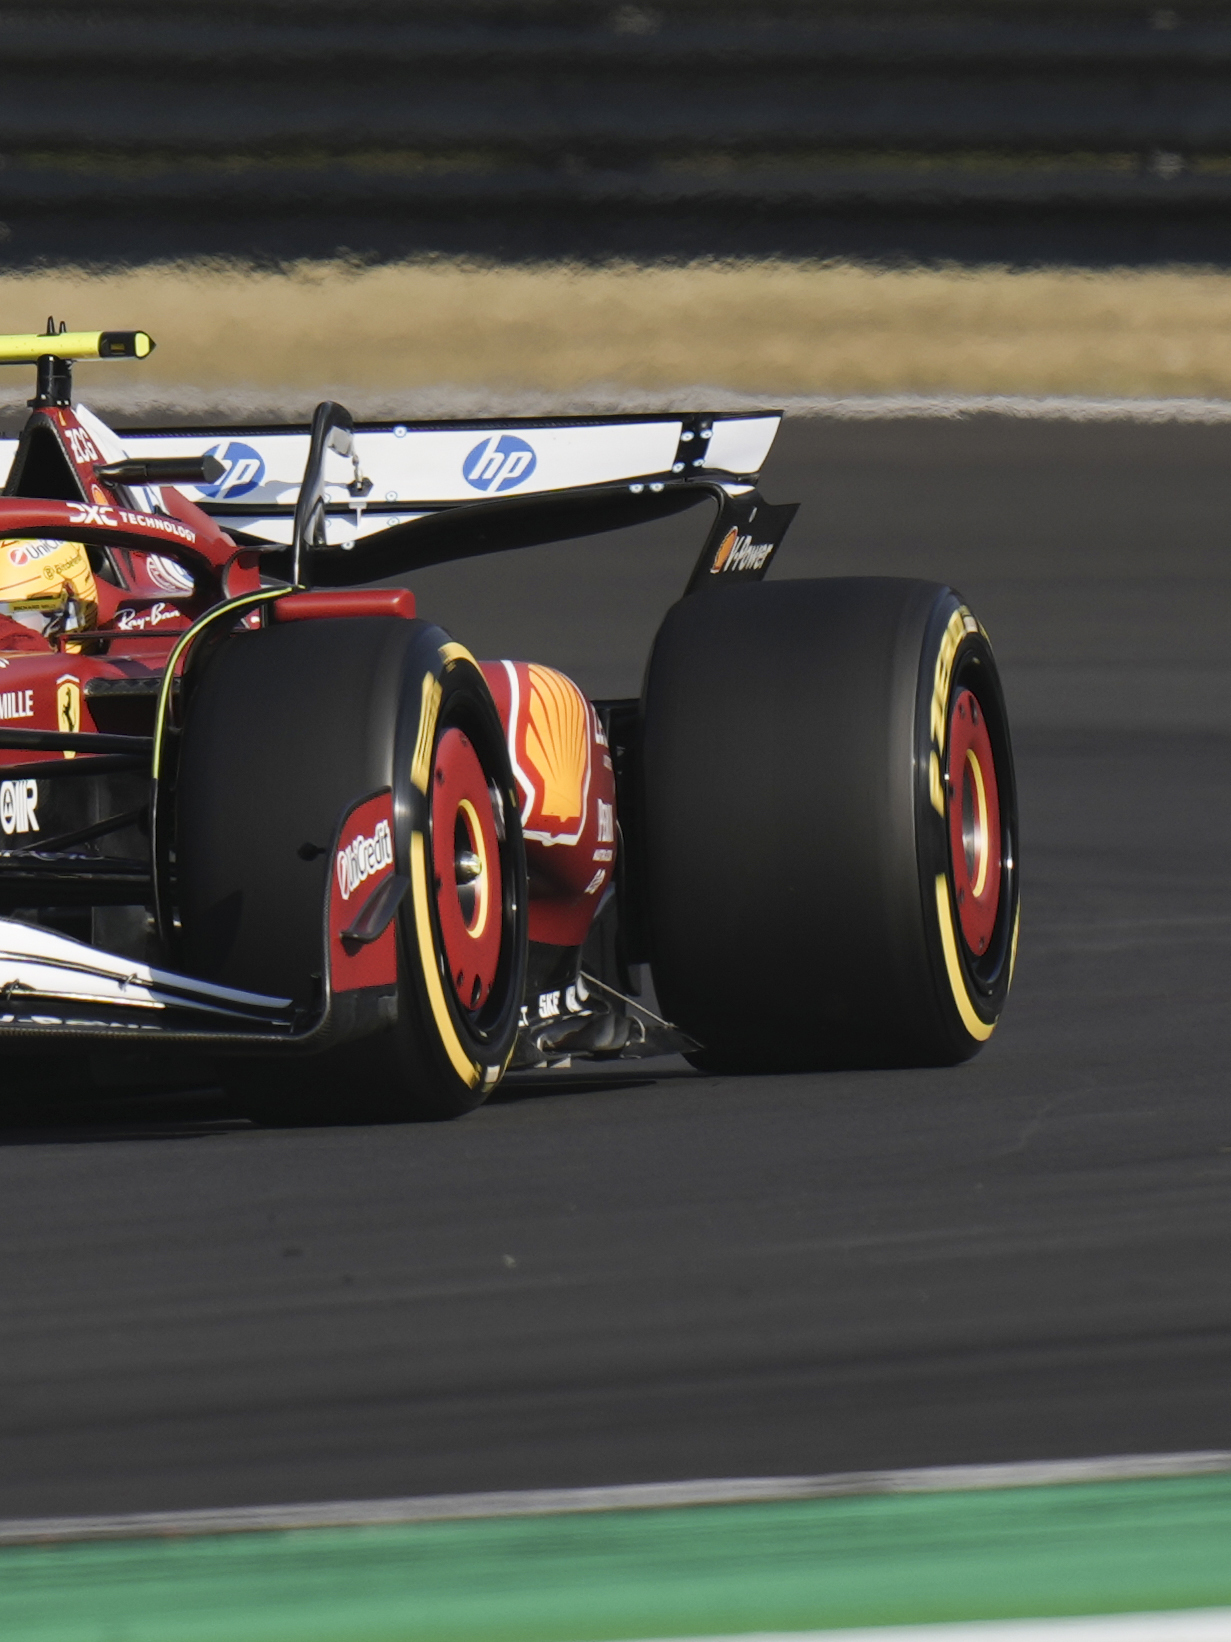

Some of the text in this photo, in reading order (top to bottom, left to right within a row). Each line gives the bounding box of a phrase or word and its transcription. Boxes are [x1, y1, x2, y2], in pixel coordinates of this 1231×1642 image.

[470, 435, 534, 492] hp
[66, 502, 196, 543] DXC TECHNOLOGY
[114, 602, 181, 630] Ray-Ban
[539, 990, 561, 1018] SKF
